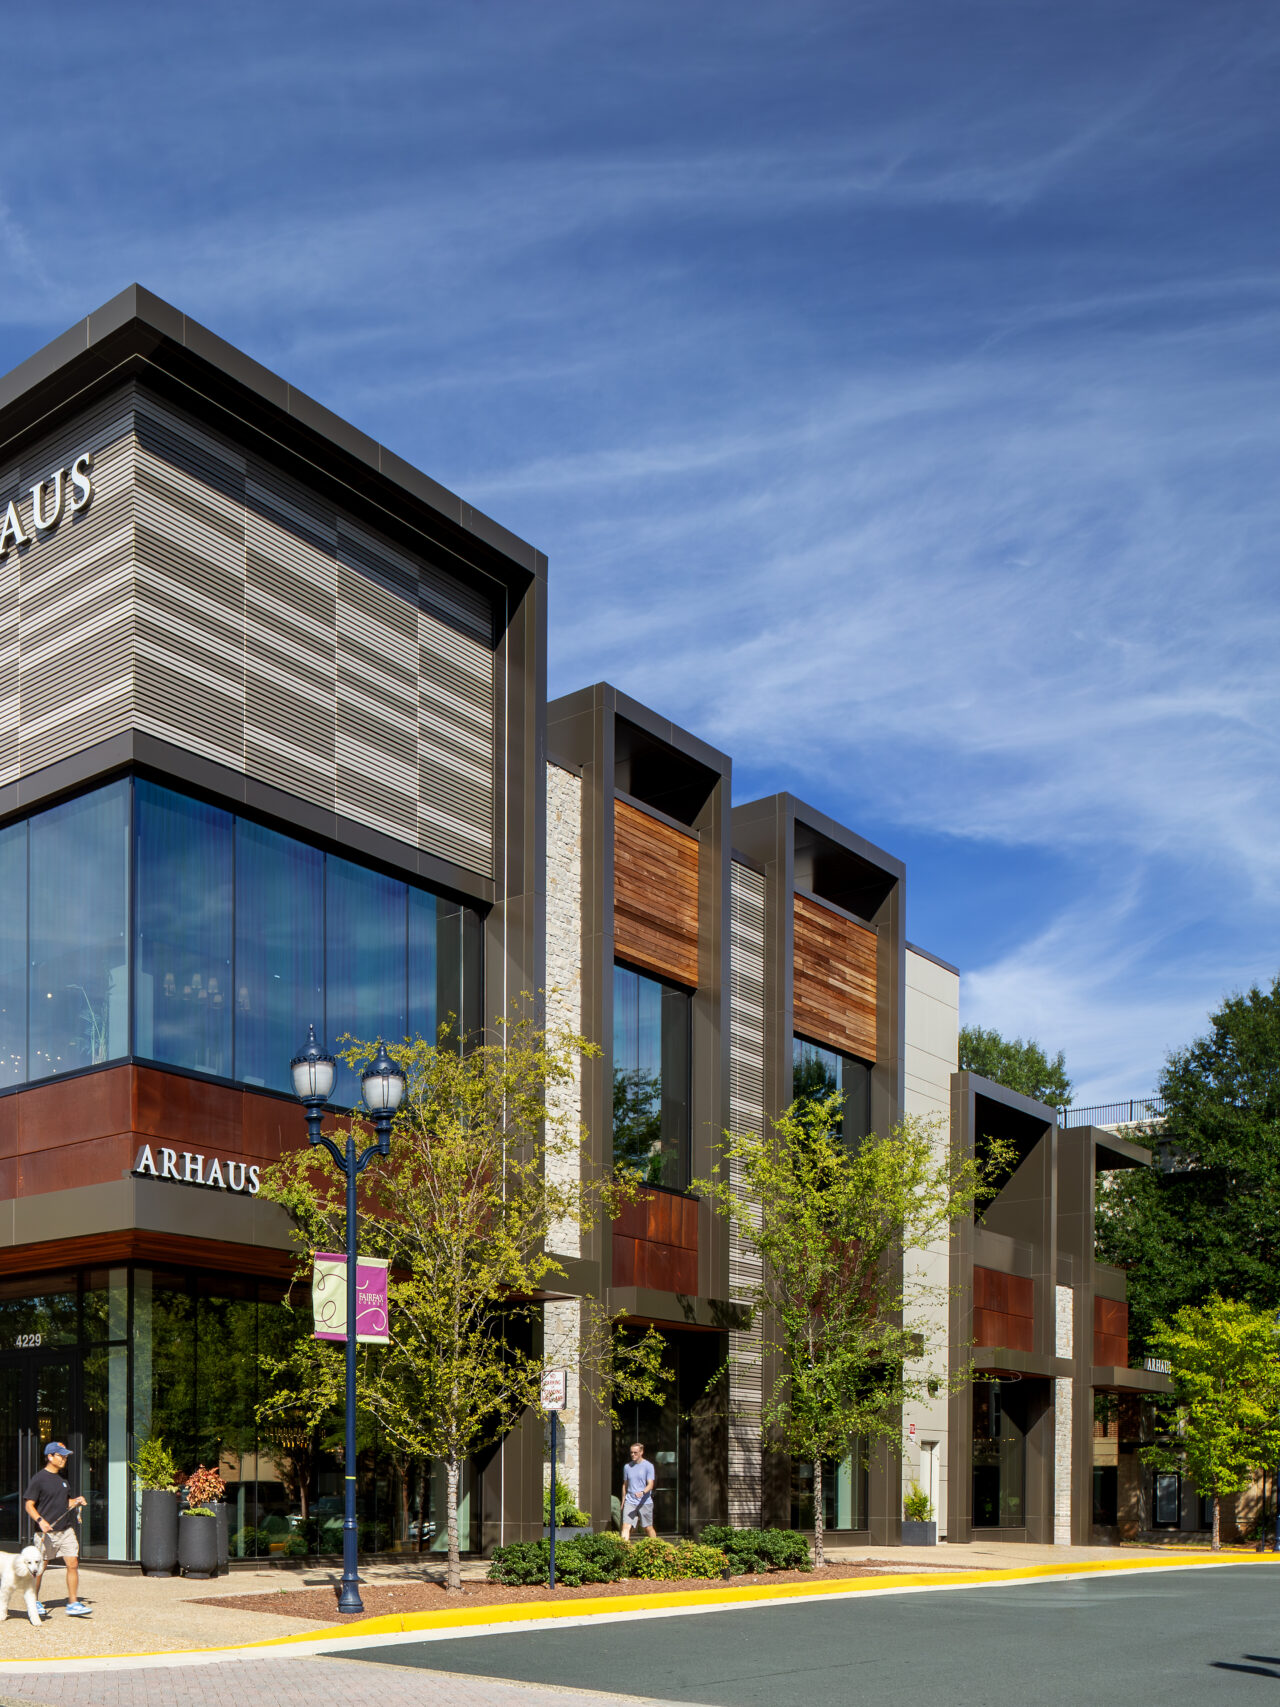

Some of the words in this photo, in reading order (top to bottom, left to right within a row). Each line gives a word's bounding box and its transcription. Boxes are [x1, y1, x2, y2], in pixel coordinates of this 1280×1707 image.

[136, 1144, 260, 1194] ARHAUS
[358, 1293, 384, 1303] FAIRFAX
[16, 1333, 42, 1347] 4229
